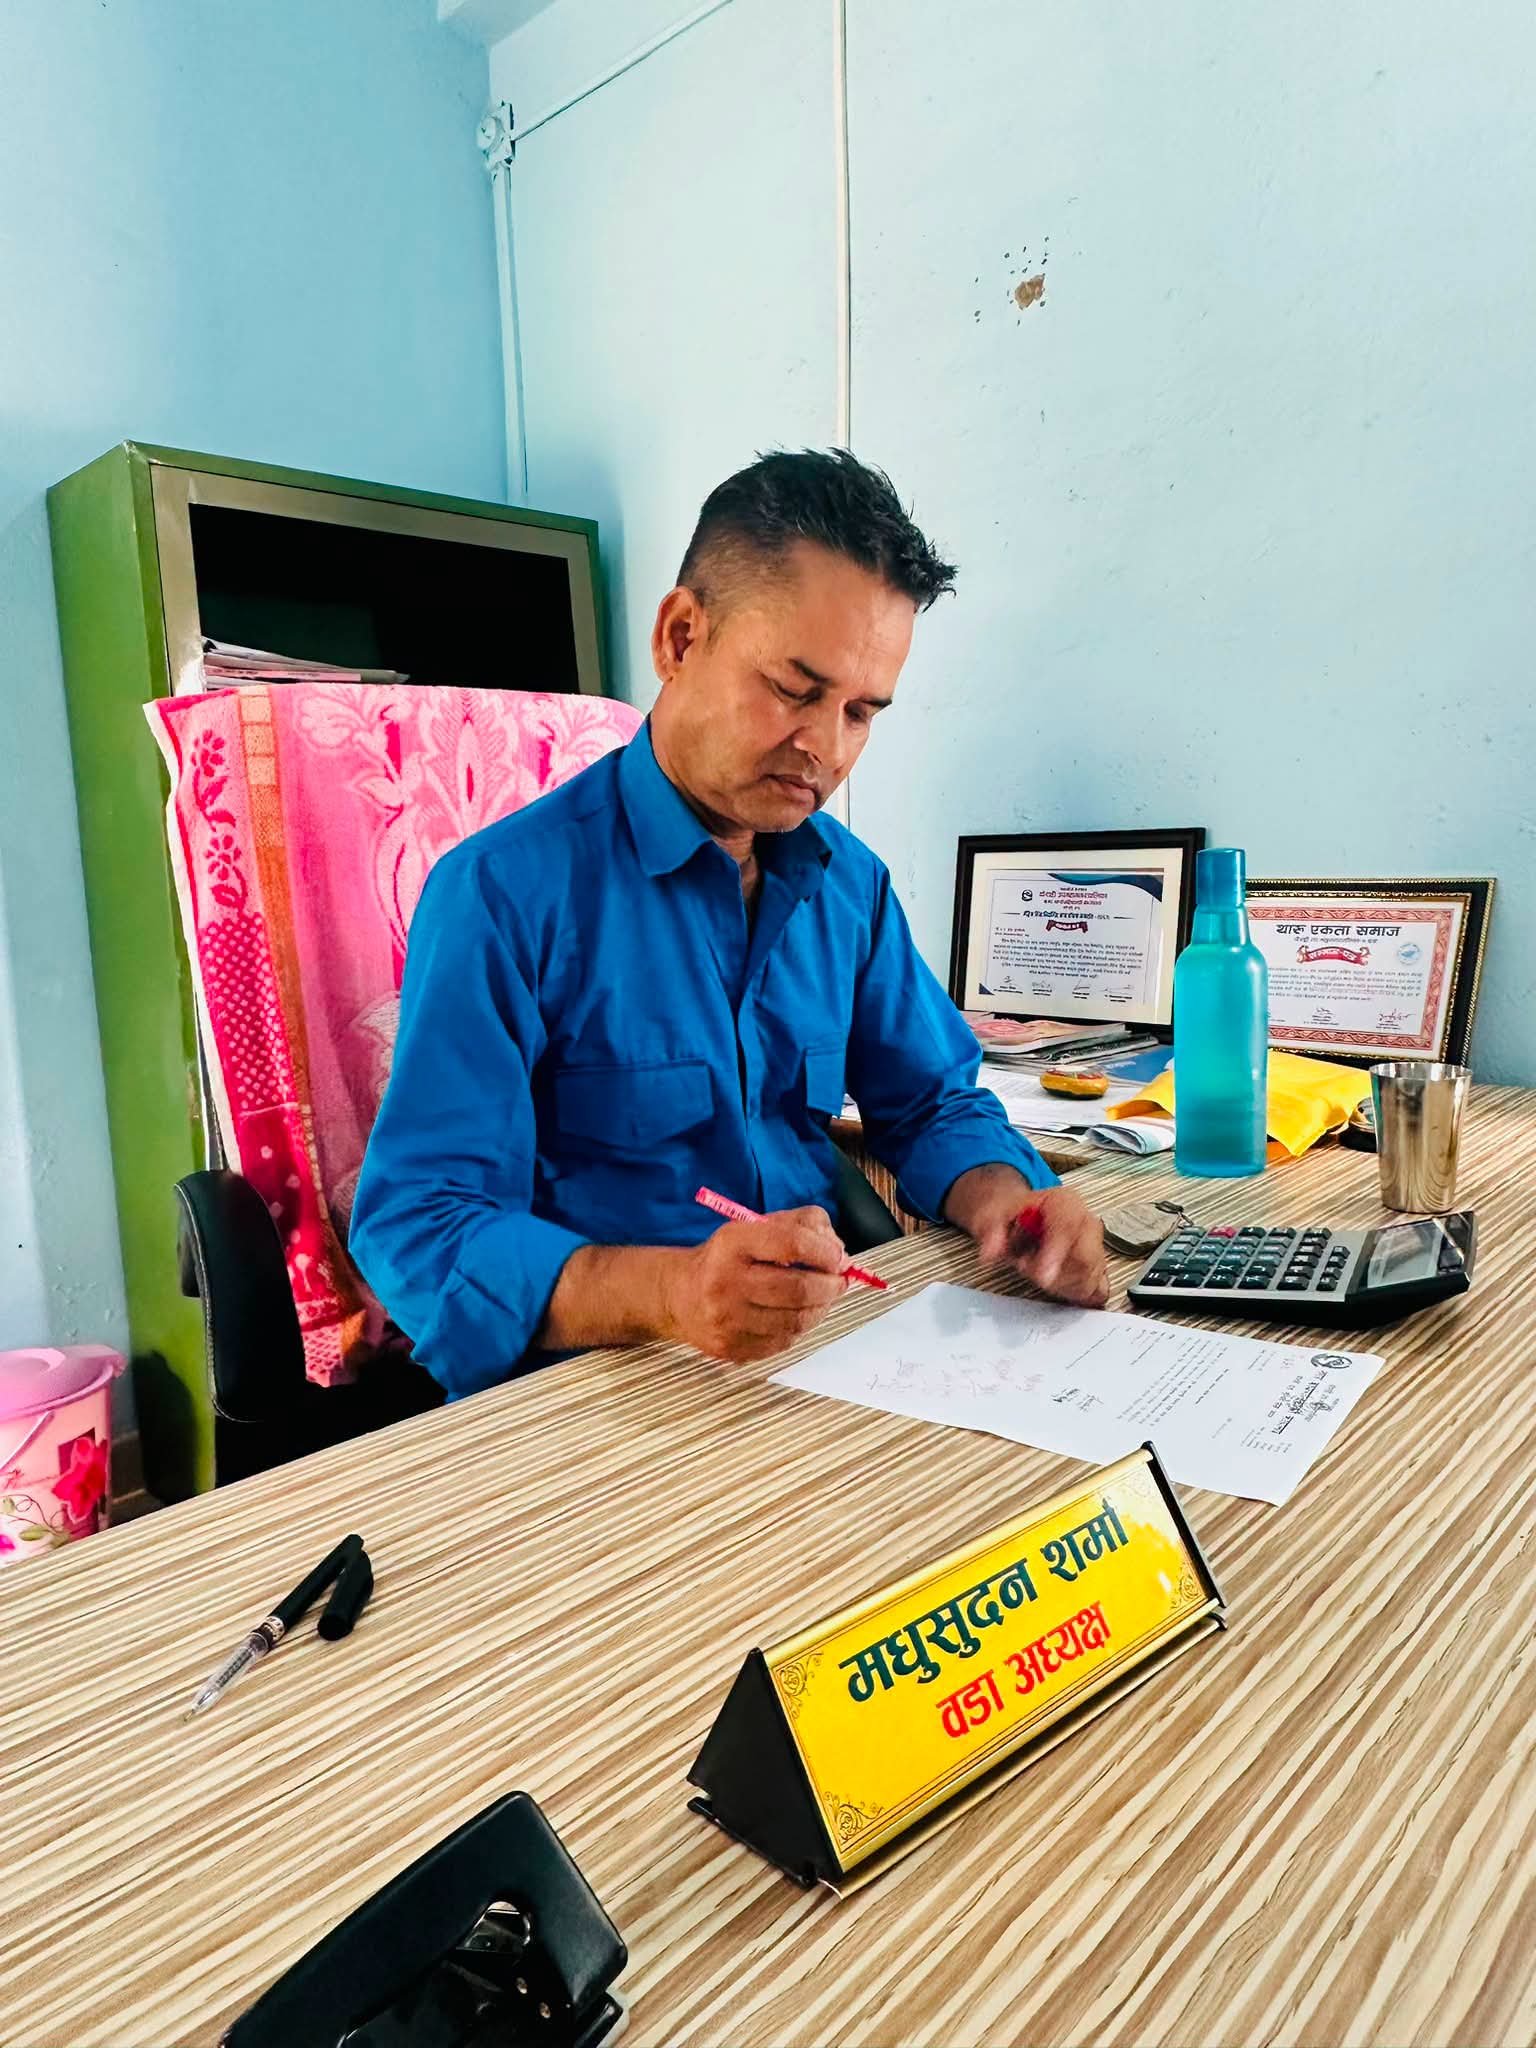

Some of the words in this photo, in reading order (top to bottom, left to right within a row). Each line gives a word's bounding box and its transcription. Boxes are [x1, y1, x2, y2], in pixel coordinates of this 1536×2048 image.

[1310, 925, 1351, 936] एकता
[1356, 926, 1401, 937] समाज
[838, 1557, 1038, 1702] मधुसुदन
[936, 1669, 1004, 1738] वडा
[1003, 1601, 1111, 1694] अध्यक्ष
